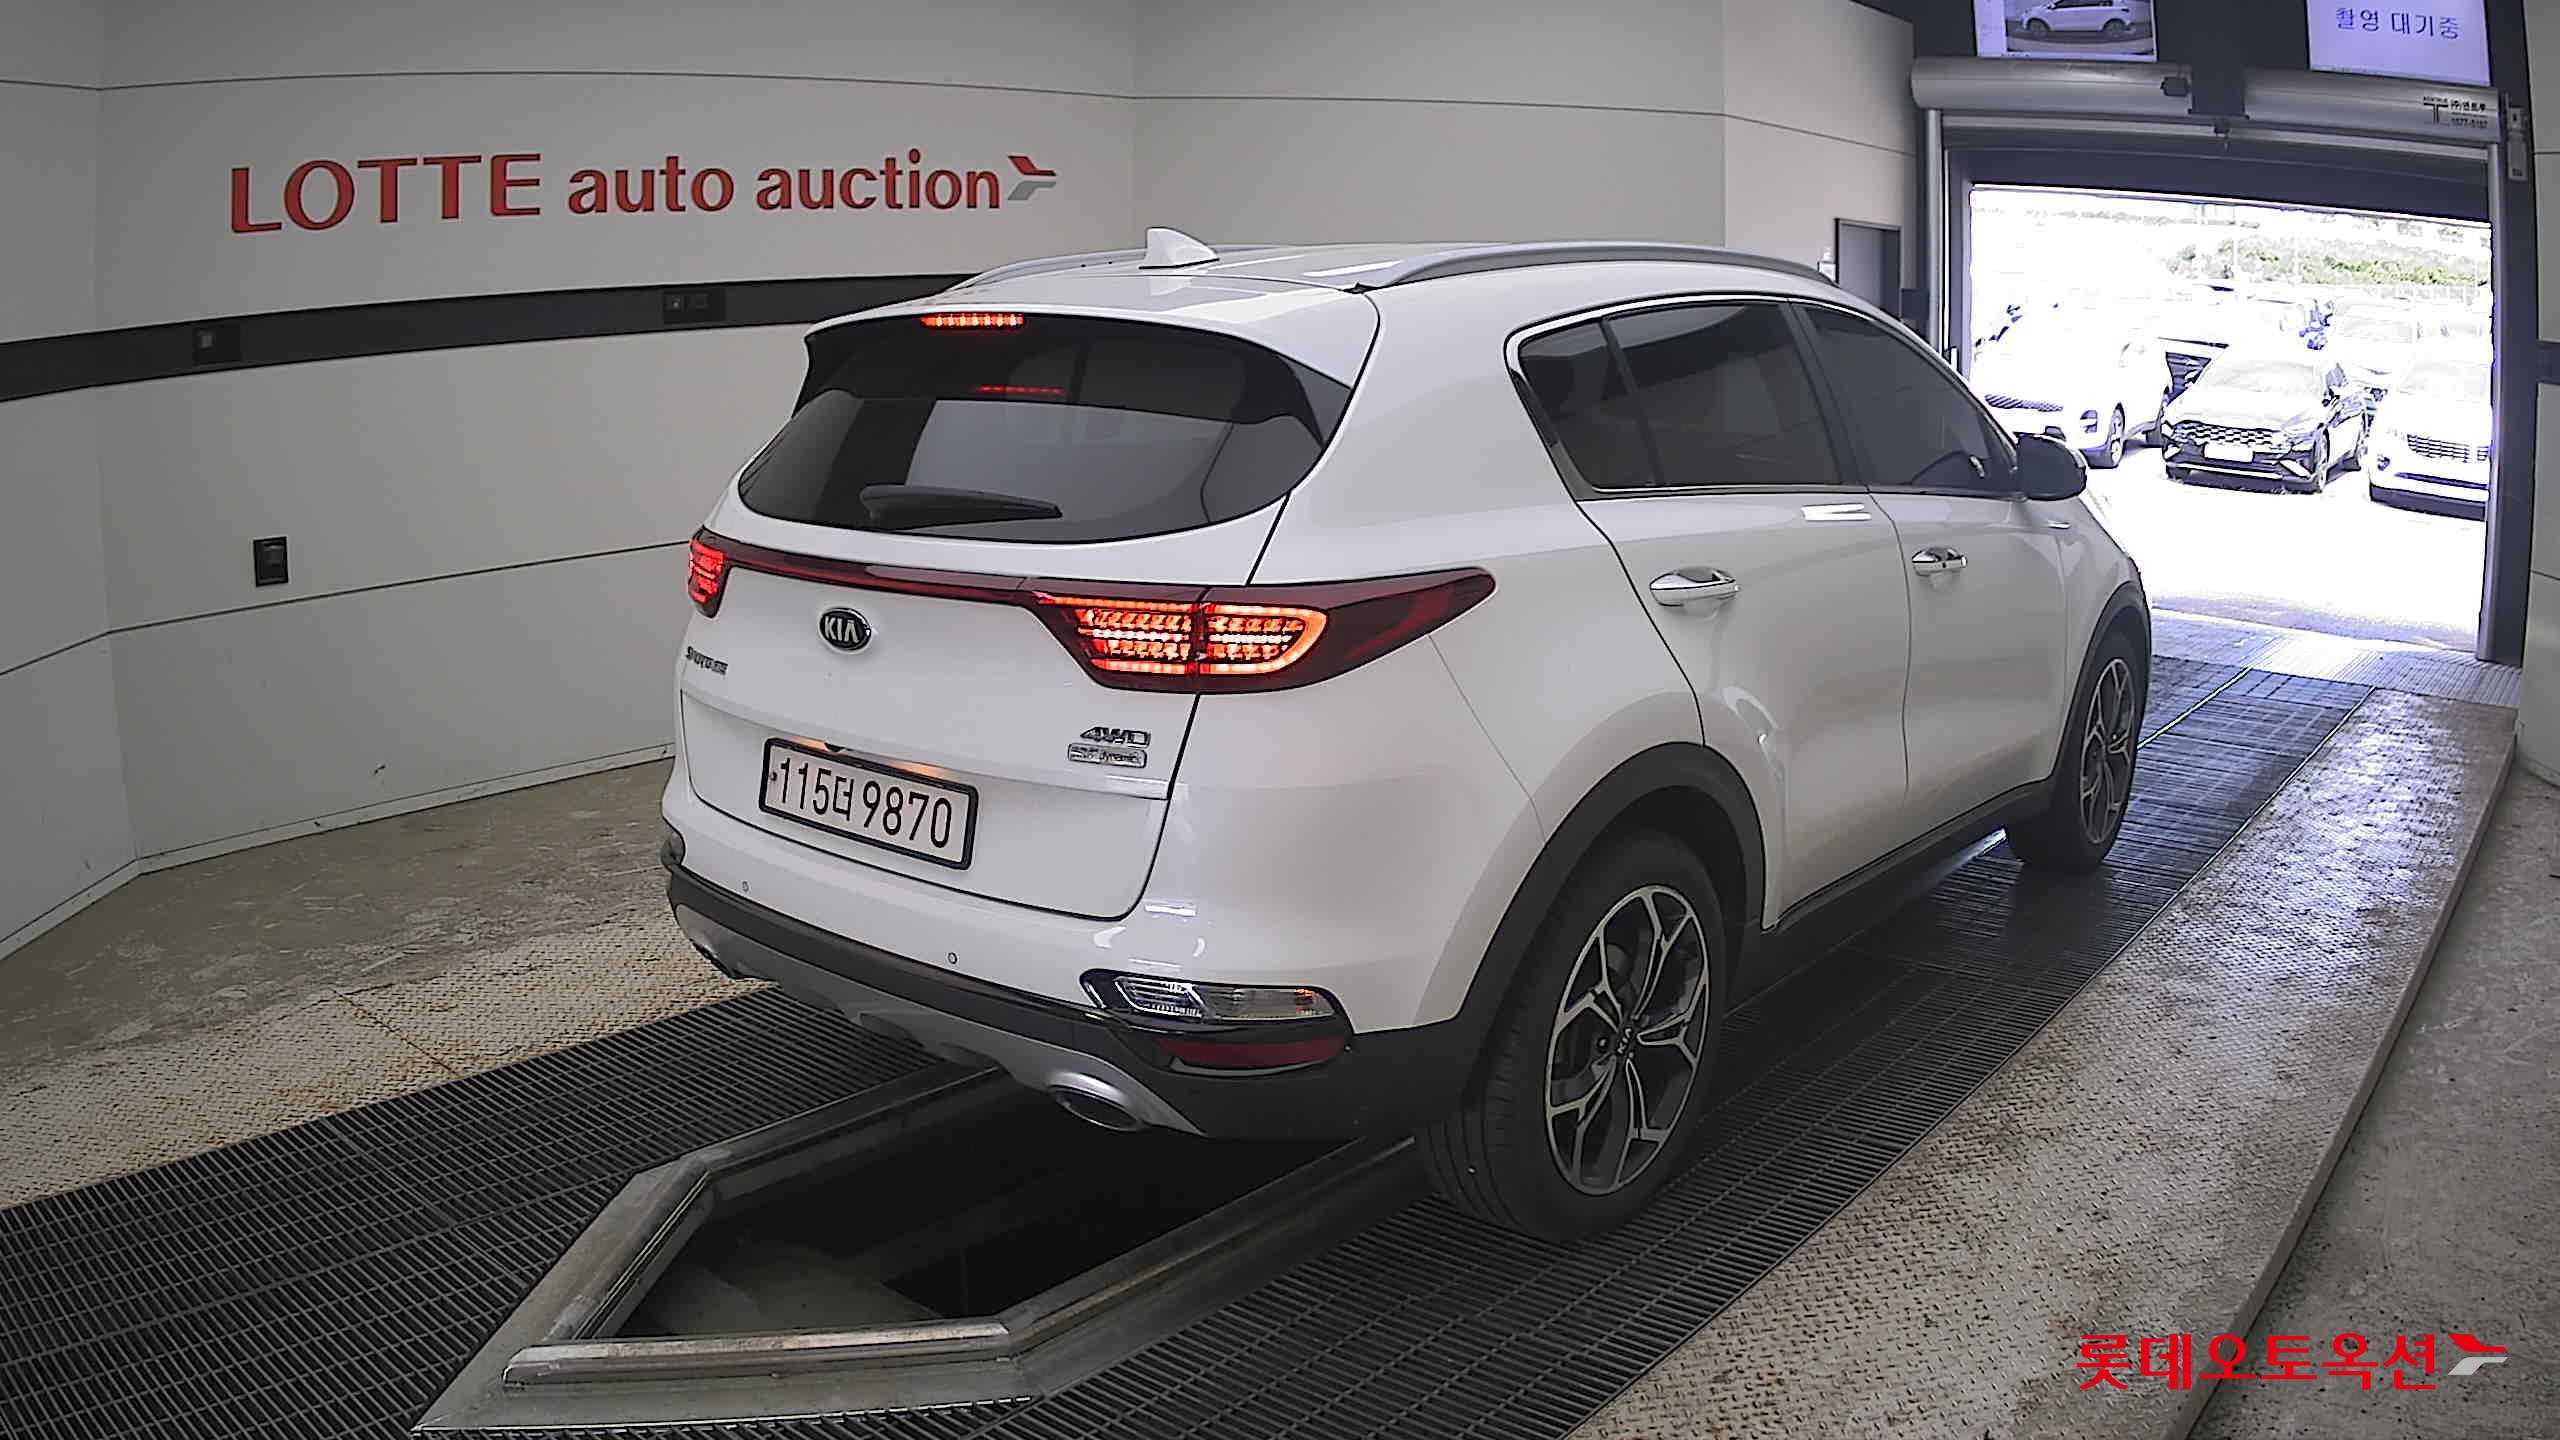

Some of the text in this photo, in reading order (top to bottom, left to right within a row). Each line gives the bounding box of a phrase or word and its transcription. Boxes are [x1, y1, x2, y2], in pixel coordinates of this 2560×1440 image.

[2391, 12, 2460, 40] 대기중
[231, 148, 1001, 234] LOTTE auto auction
[824, 614, 860, 643] KIA
[1080, 726, 1152, 748] 4WD
